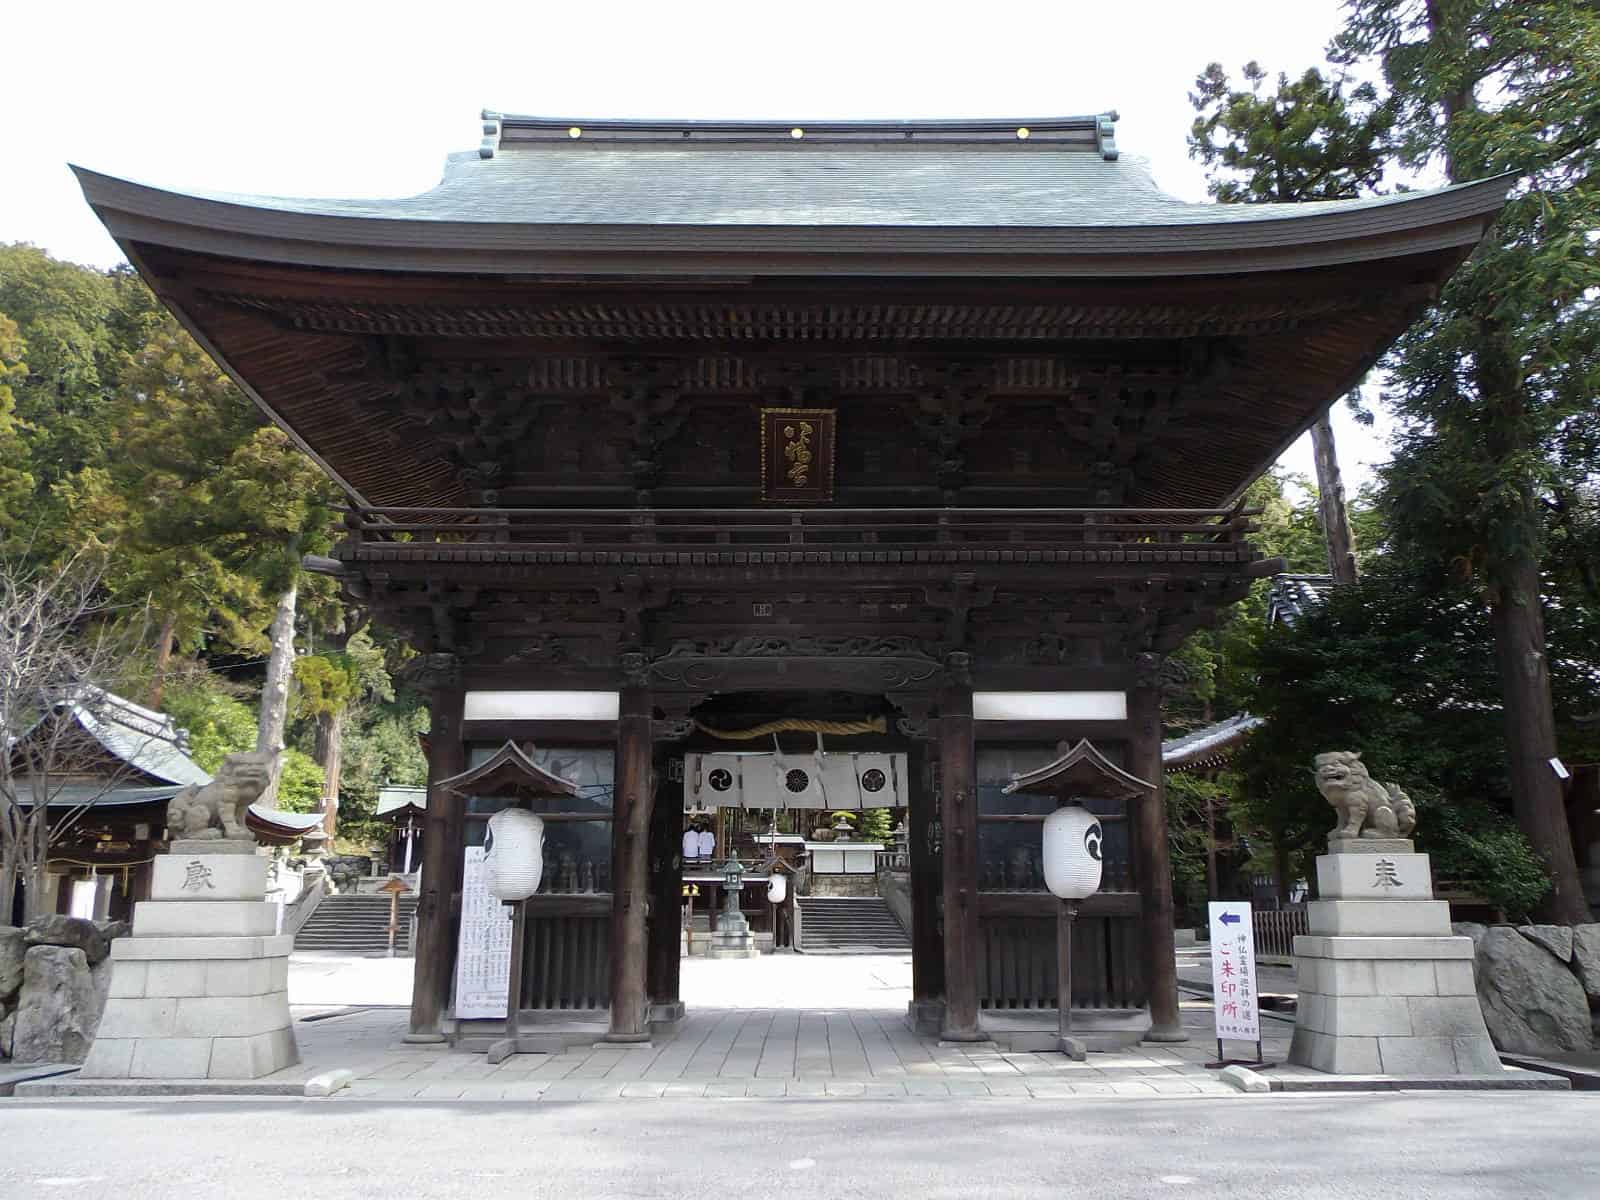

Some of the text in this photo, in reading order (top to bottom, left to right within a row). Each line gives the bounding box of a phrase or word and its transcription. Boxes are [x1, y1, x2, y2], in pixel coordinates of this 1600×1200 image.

[1371, 858, 1405, 892] 奉
[1220, 943, 1238, 1019] ご朱印所
